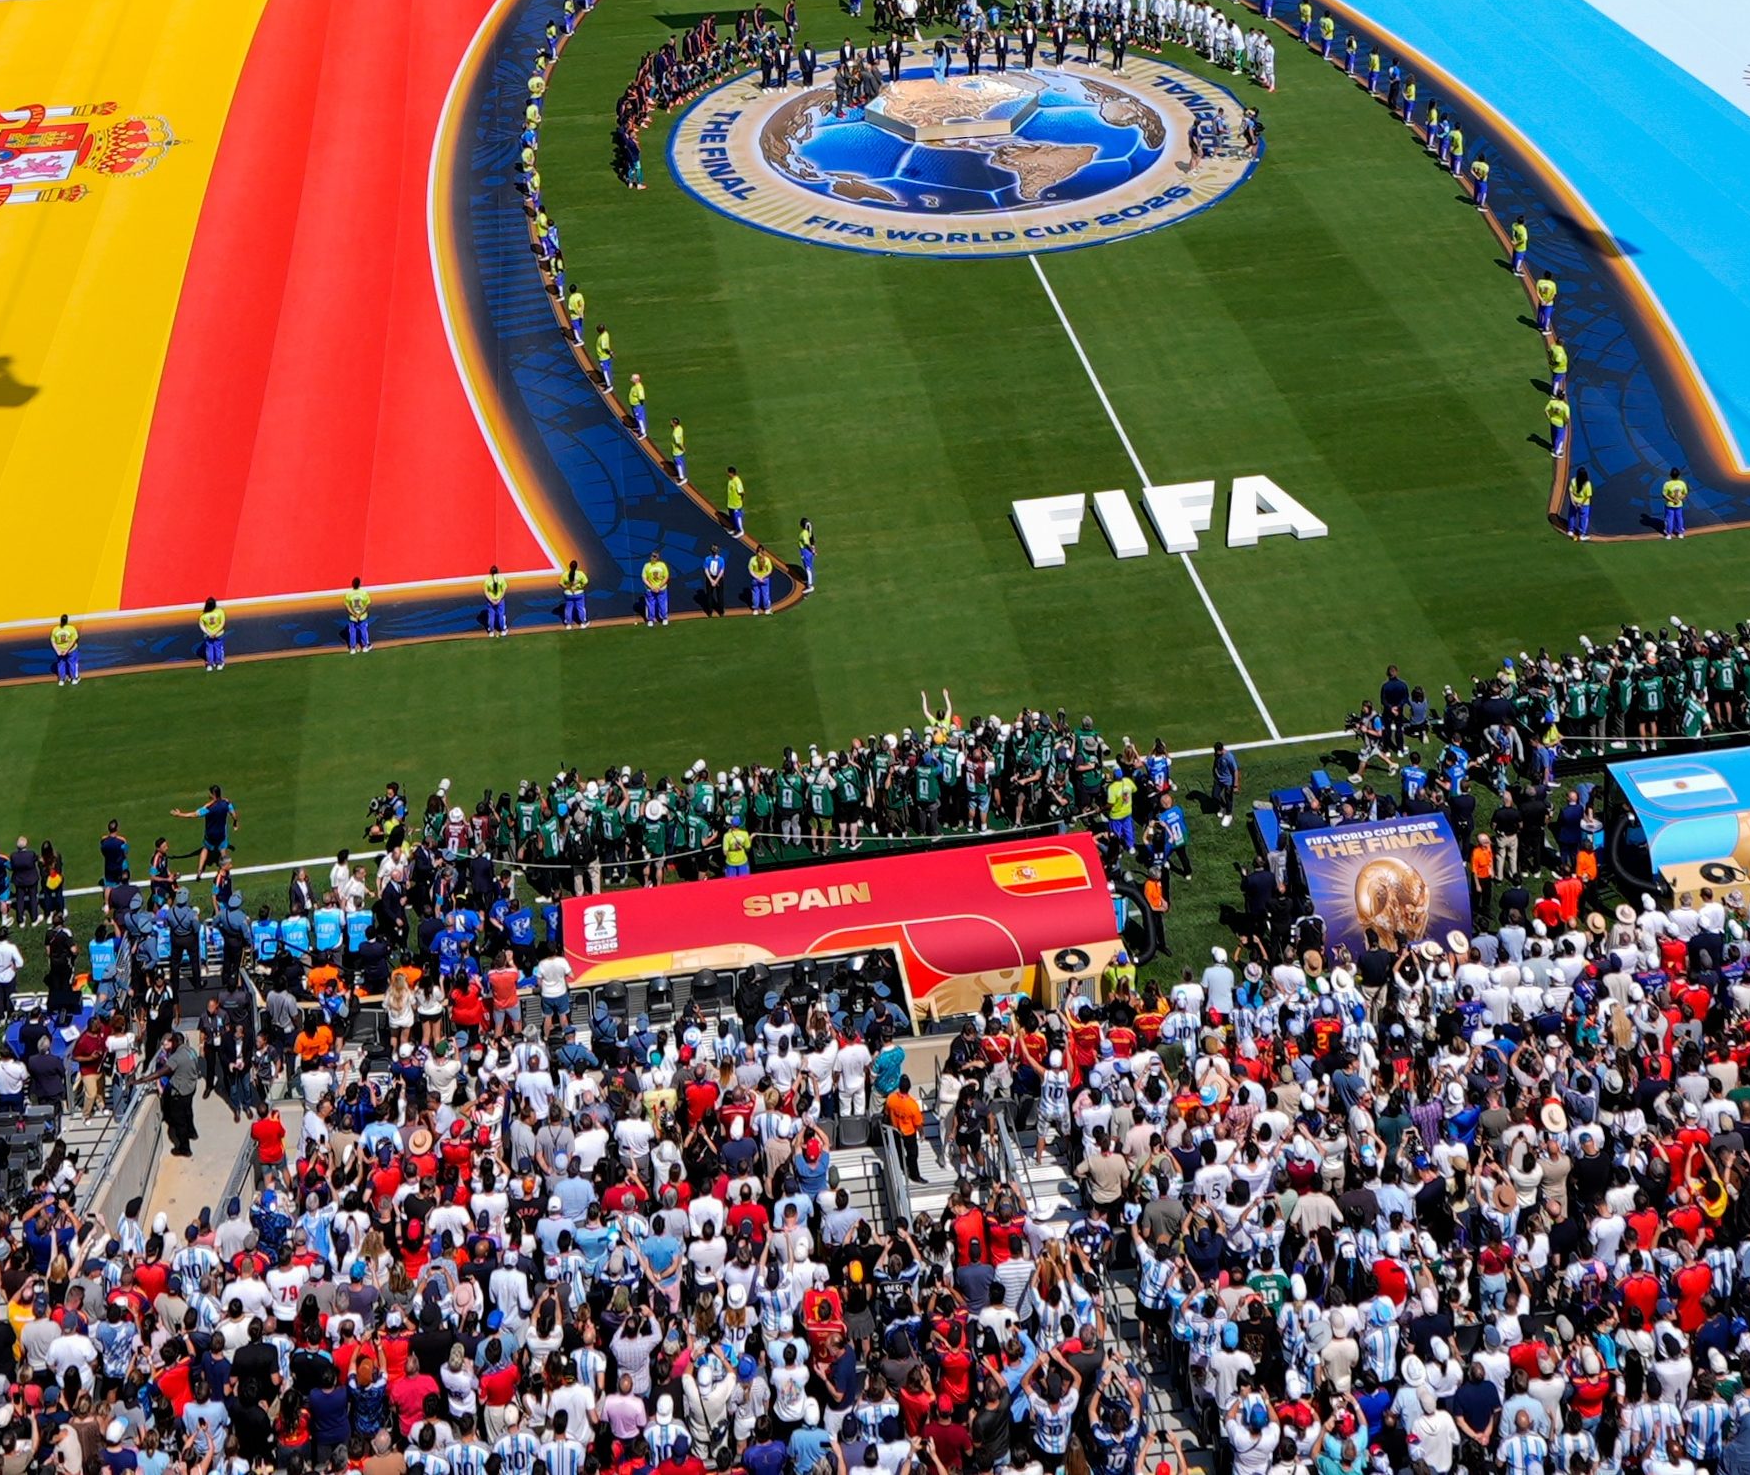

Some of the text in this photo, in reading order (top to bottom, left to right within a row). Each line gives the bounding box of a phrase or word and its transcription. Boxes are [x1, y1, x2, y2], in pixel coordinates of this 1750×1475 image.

[697, 108, 757, 202] THE FINAL
[804, 186, 1193, 244] FIFA WORLD CUP 2026
[1012, 474, 1329, 568] FIFA
[1304, 822, 1436, 847] FIFA WORLD CUP 2026
[1310, 831, 1444, 857] THE FINAL
[742, 882, 871, 917] SPAIN
[278, 1284, 300, 1302] 79
